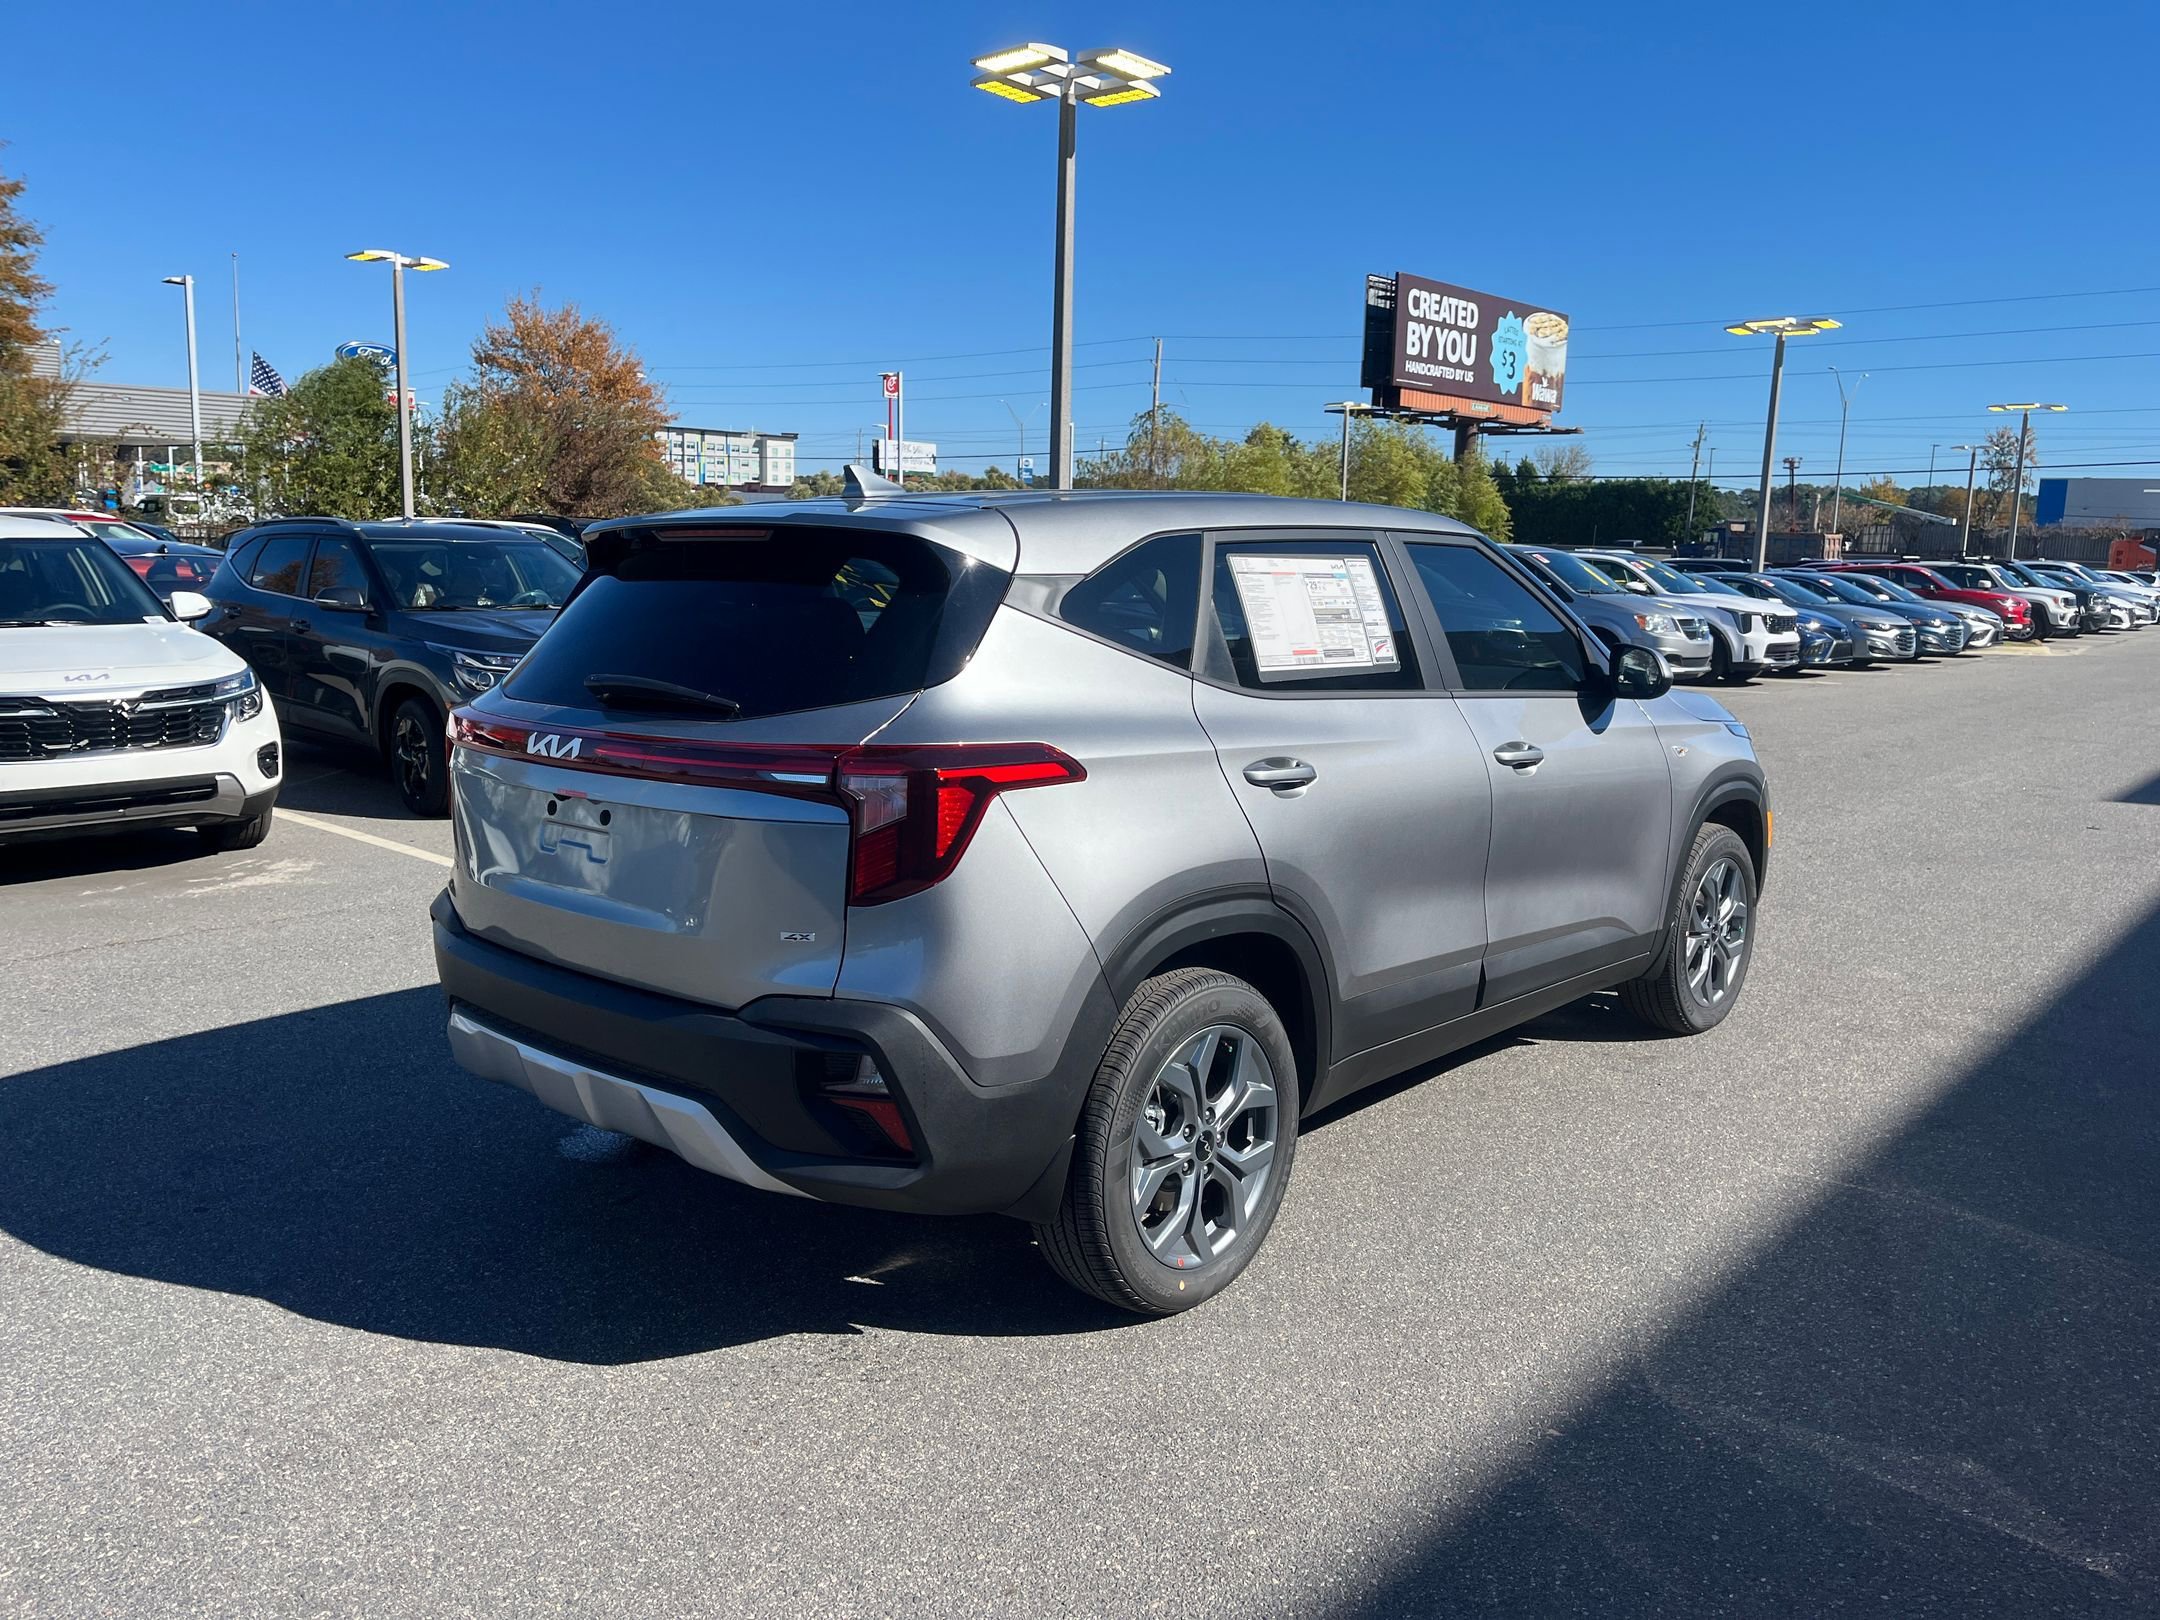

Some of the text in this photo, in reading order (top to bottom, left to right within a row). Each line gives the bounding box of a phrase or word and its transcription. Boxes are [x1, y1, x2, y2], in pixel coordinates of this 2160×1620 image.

[1408, 288, 1479, 329] CREATED
[1406, 321, 1477, 366] BY YOU
[1405, 360, 1474, 383] HANDCRAFTED BY US
[1532, 383, 1557, 404] Wawa
[526, 731, 583, 760] KIA
